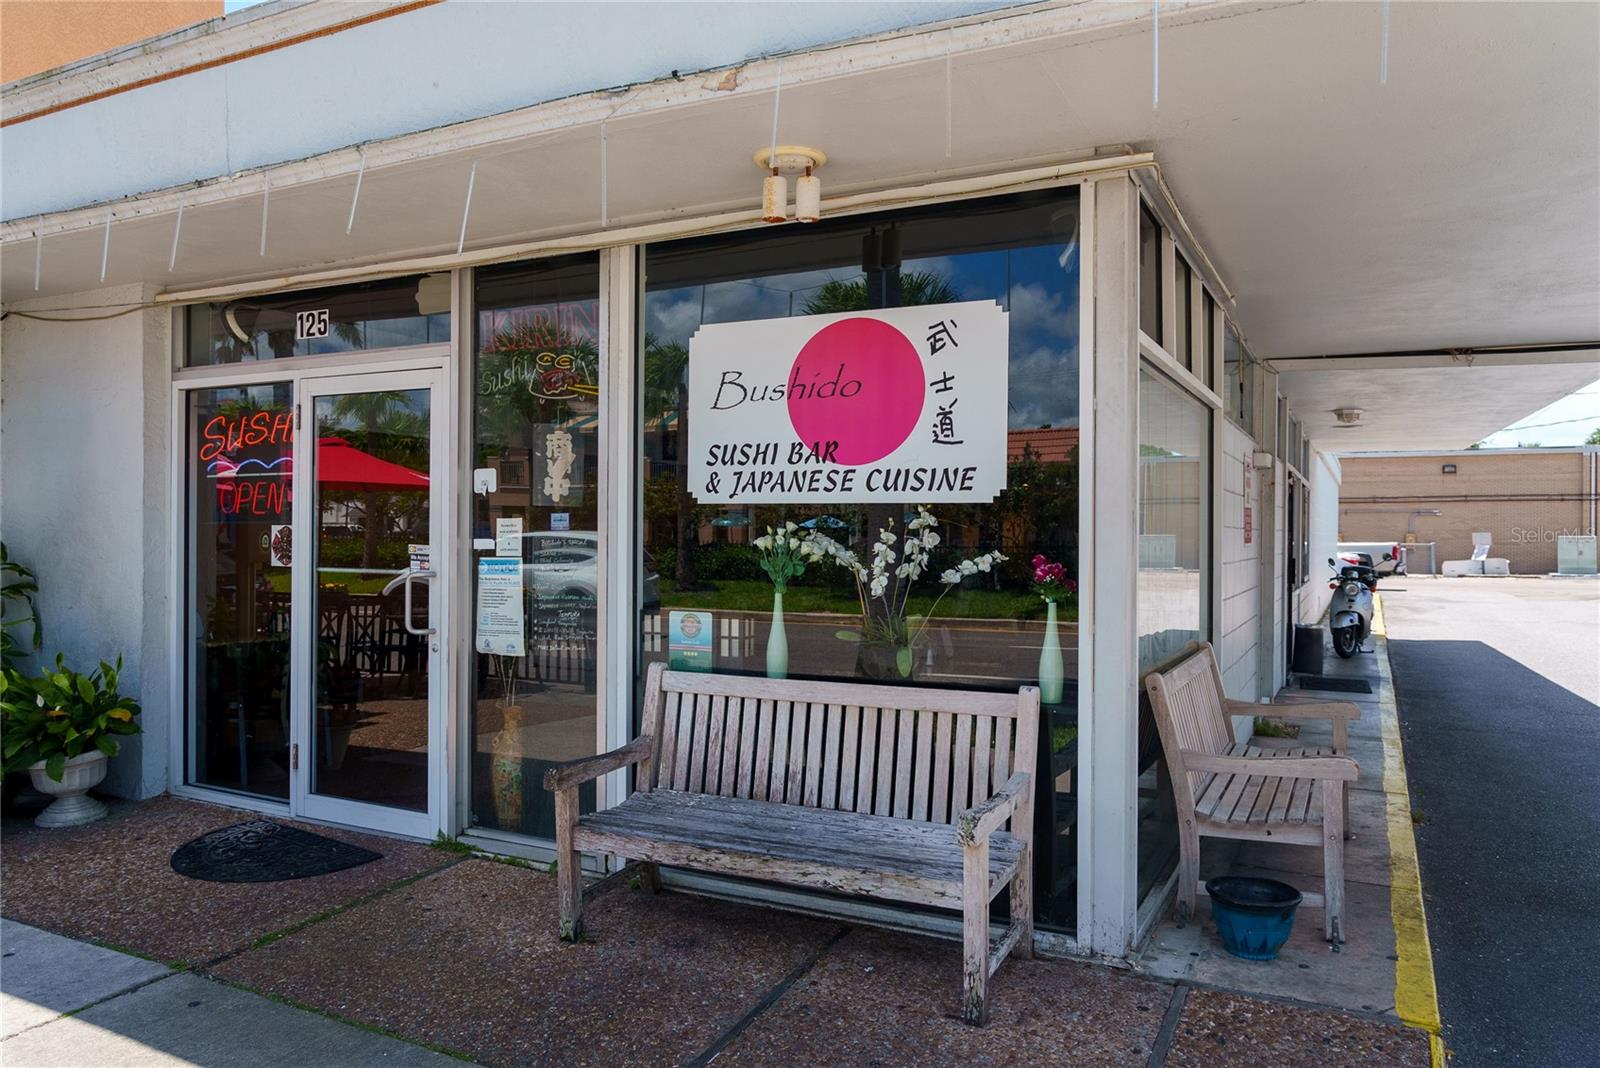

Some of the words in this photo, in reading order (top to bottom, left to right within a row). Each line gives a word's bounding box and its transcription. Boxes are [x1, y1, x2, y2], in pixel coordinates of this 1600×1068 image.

[298, 311, 327, 338] 125
[481, 303, 599, 352] KIRIN
[481, 355, 528, 395] Sushi
[710, 363, 863, 410] Bushido
[706, 442, 779, 467] SUSHI
[787, 440, 839, 466] BAR
[220, 481, 287, 515] OPEN
[705, 471, 721, 494] &
[728, 469, 856, 499] JAPANESE
[866, 466, 977, 493] CUISINE
